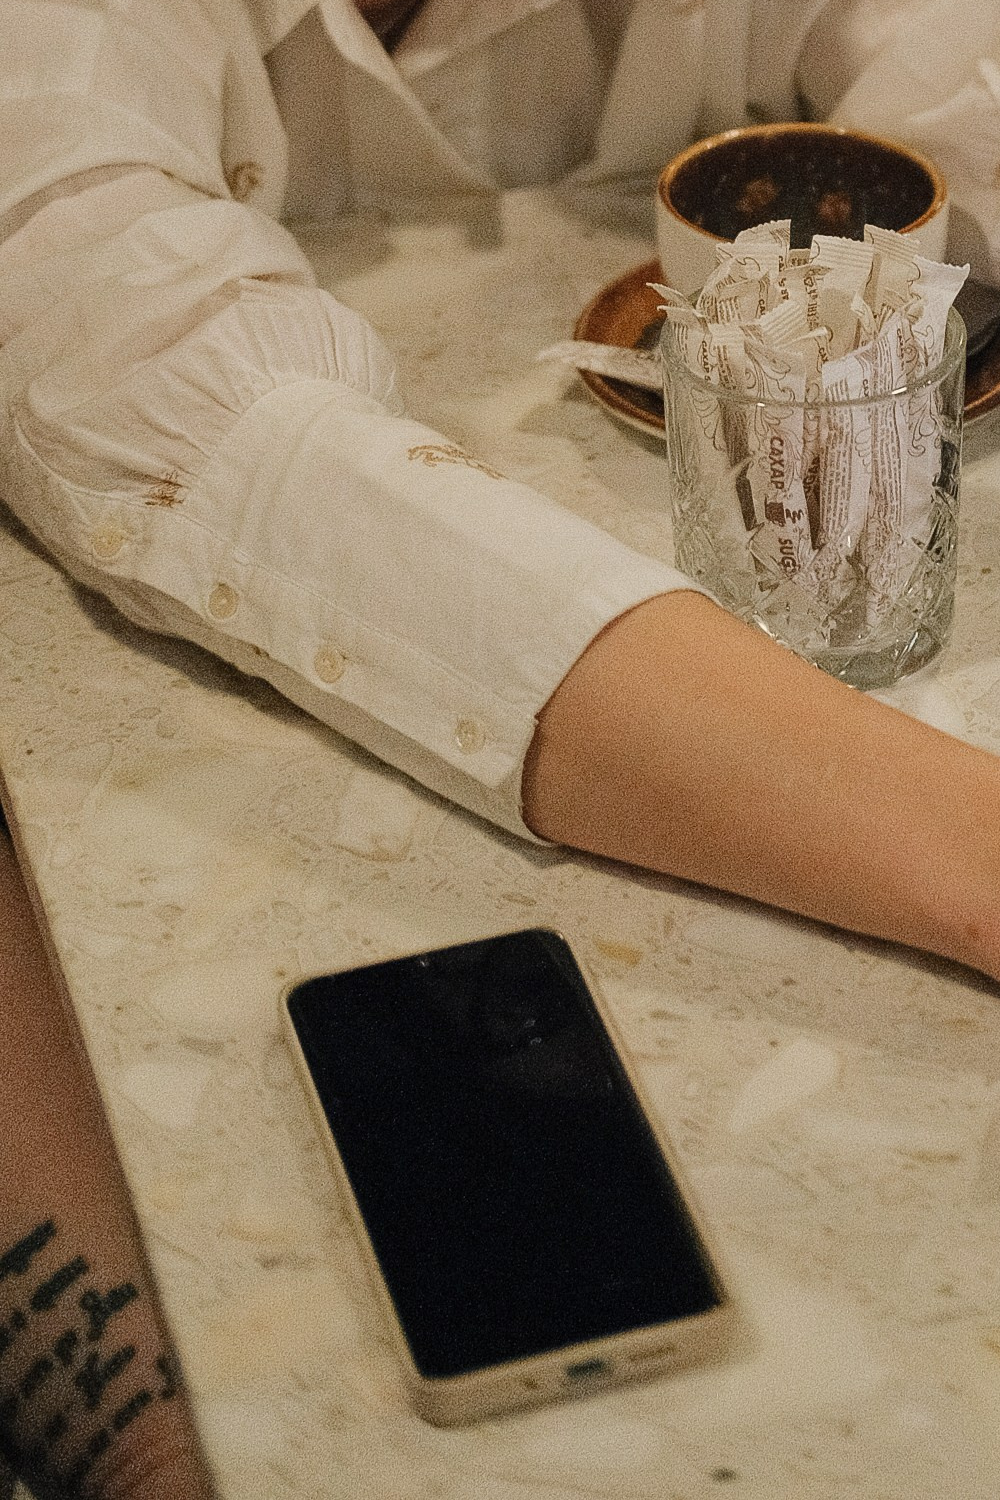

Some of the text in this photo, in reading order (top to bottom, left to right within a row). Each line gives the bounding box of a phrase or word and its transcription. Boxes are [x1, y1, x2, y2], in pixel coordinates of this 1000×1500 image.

[701, 340, 710, 372] САХАР
[768, 435, 786, 490] САХАР
[777, 536, 797, 571] SUG
